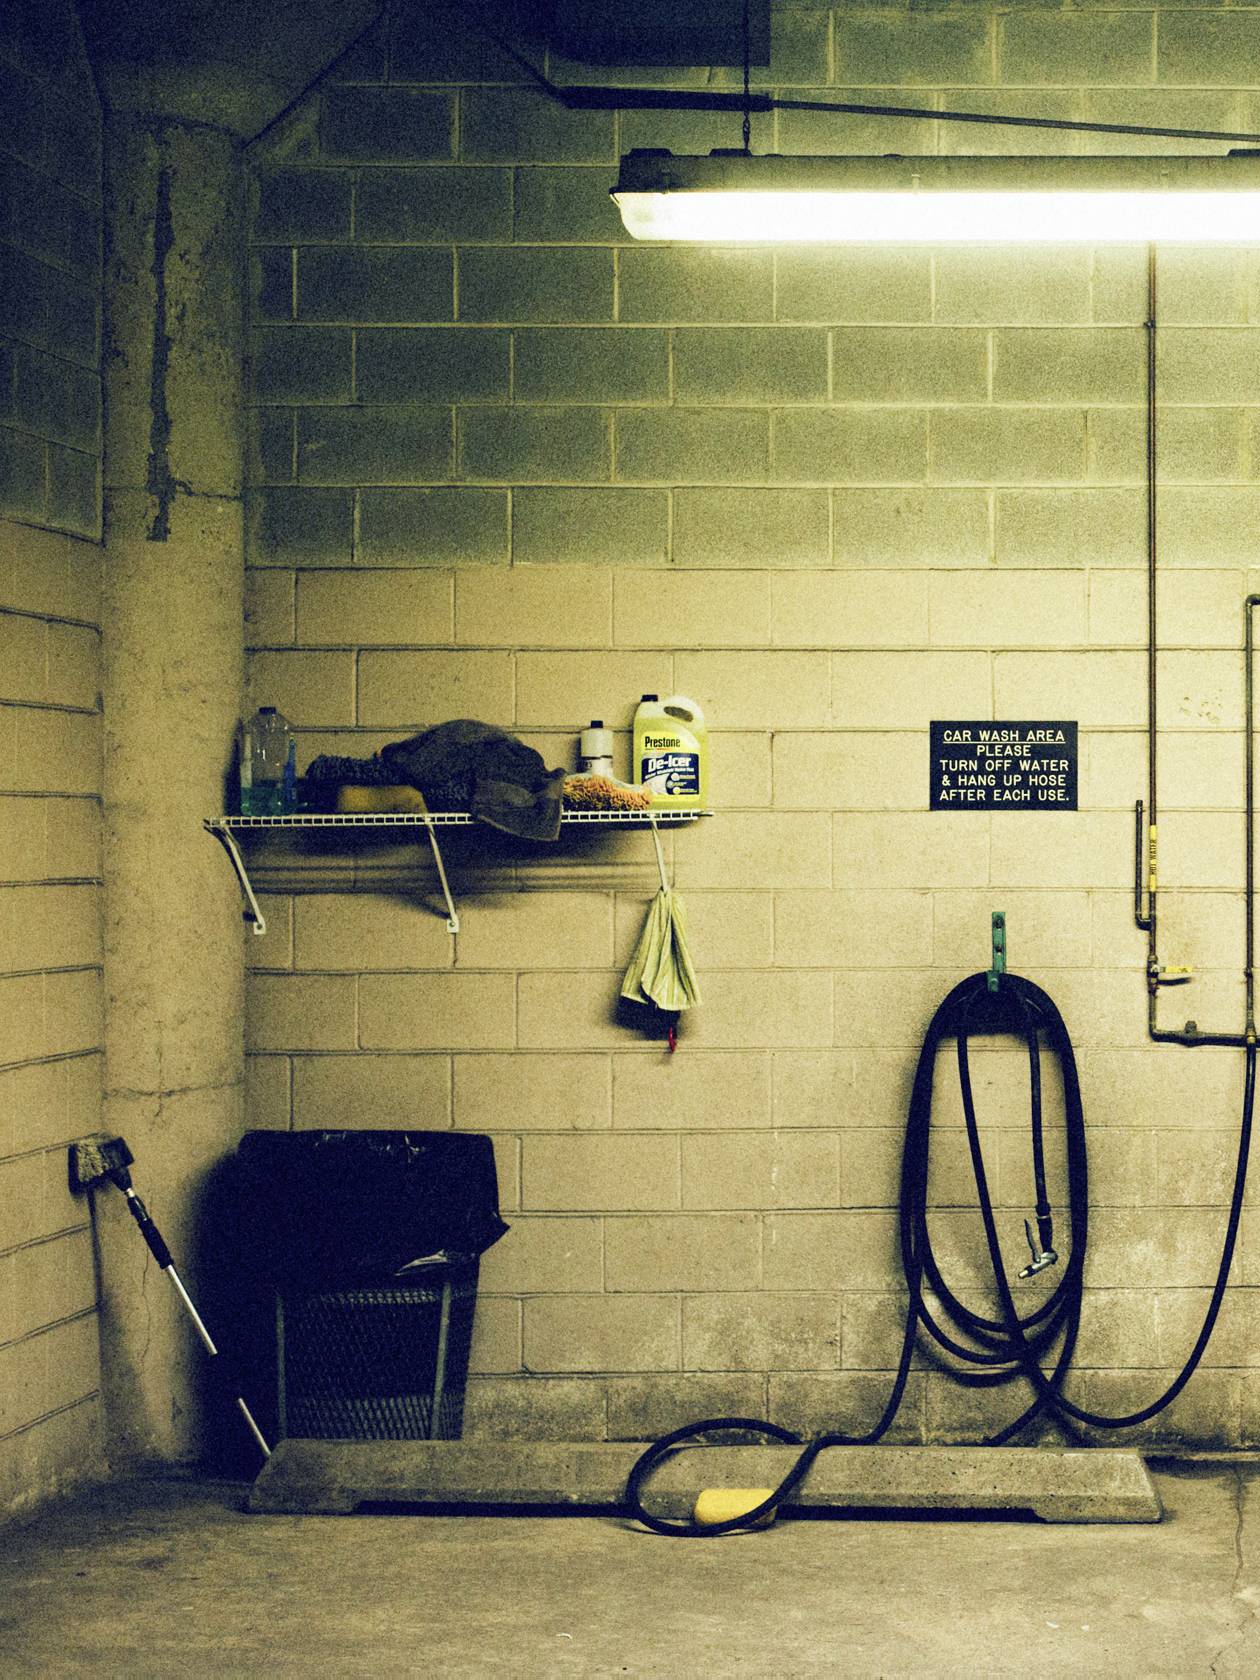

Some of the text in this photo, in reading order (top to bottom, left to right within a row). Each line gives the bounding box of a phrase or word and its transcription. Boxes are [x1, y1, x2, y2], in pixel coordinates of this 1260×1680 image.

[645, 736, 681, 748] Prestone
[943, 730, 1065, 742] CAR WASH AREA
[977, 745, 1032, 757] PLEASE
[648, 755, 692, 773] De-Icer
[939, 760, 1069, 772] TURN OFF WATER
[942, 775, 1066, 786] & HANG UP HOSE
[939, 789, 1070, 801] AFTER EACH USE.
[1149, 839, 1157, 860] WATER
